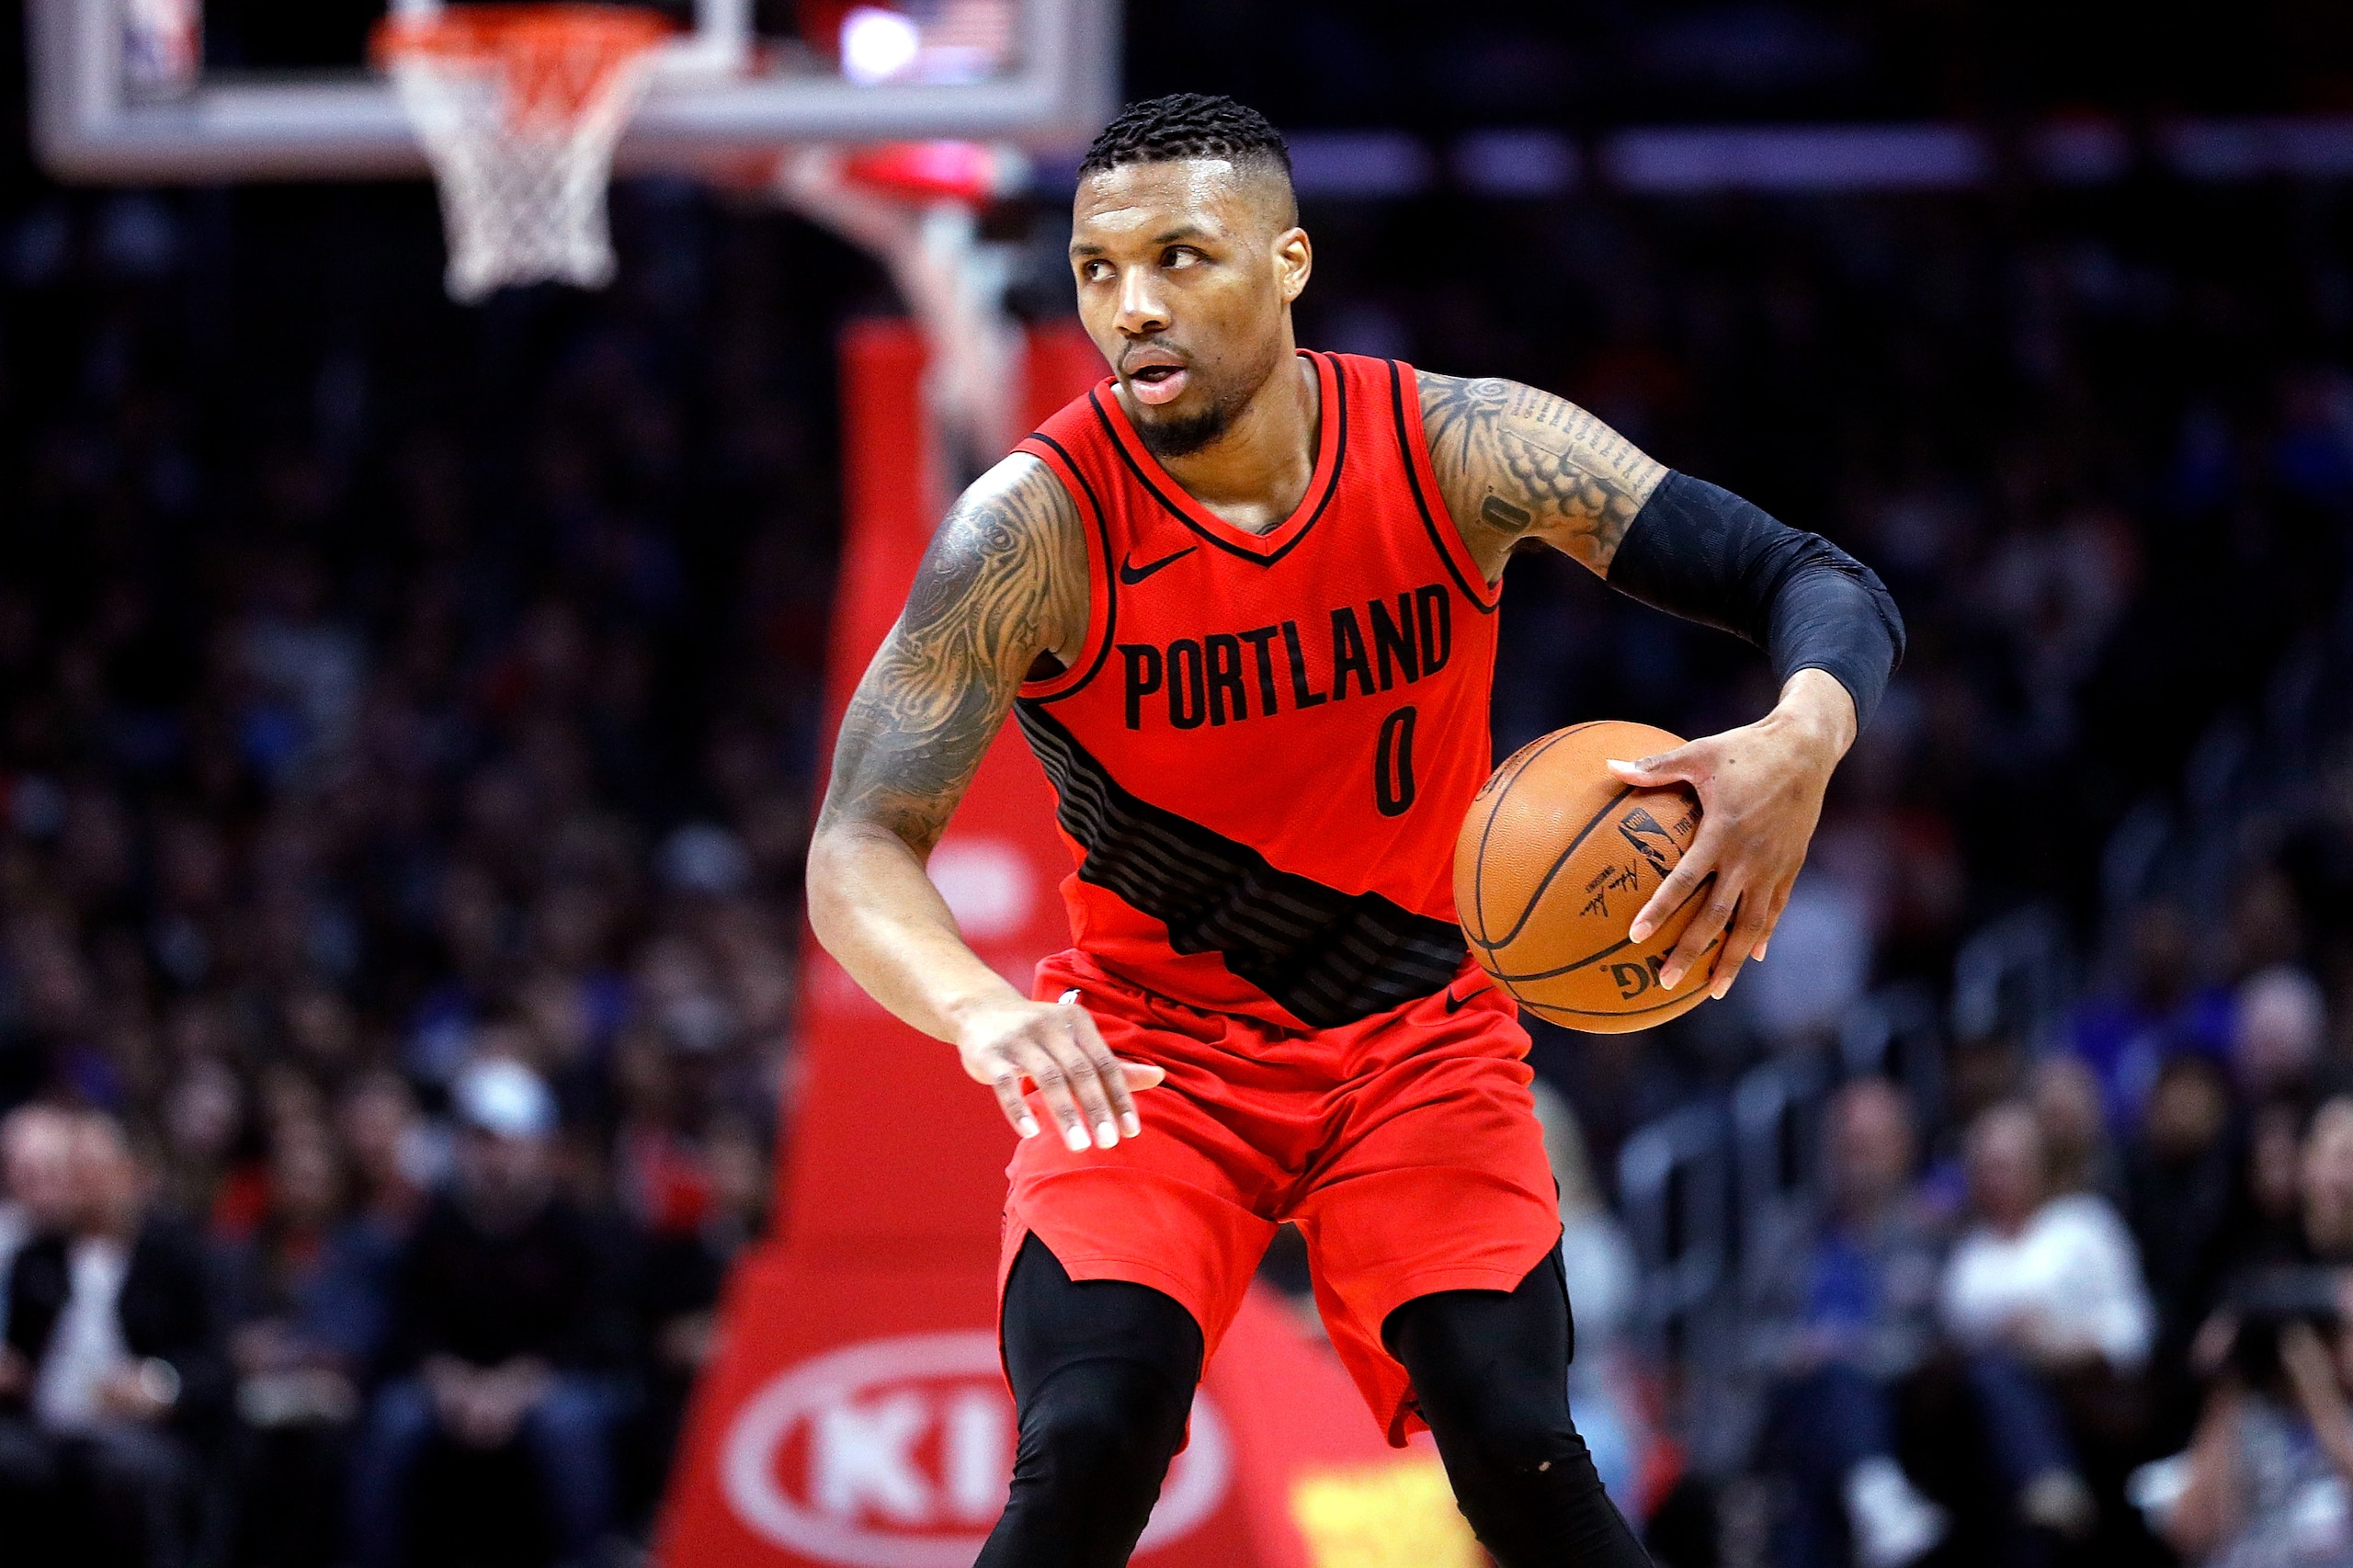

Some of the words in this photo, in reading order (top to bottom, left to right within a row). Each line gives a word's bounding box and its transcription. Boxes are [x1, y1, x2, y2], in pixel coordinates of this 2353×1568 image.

[1116, 583, 1450, 731] PORTLAND
[1375, 706, 1416, 818] 0
[816, 1394, 1002, 1522] KI
